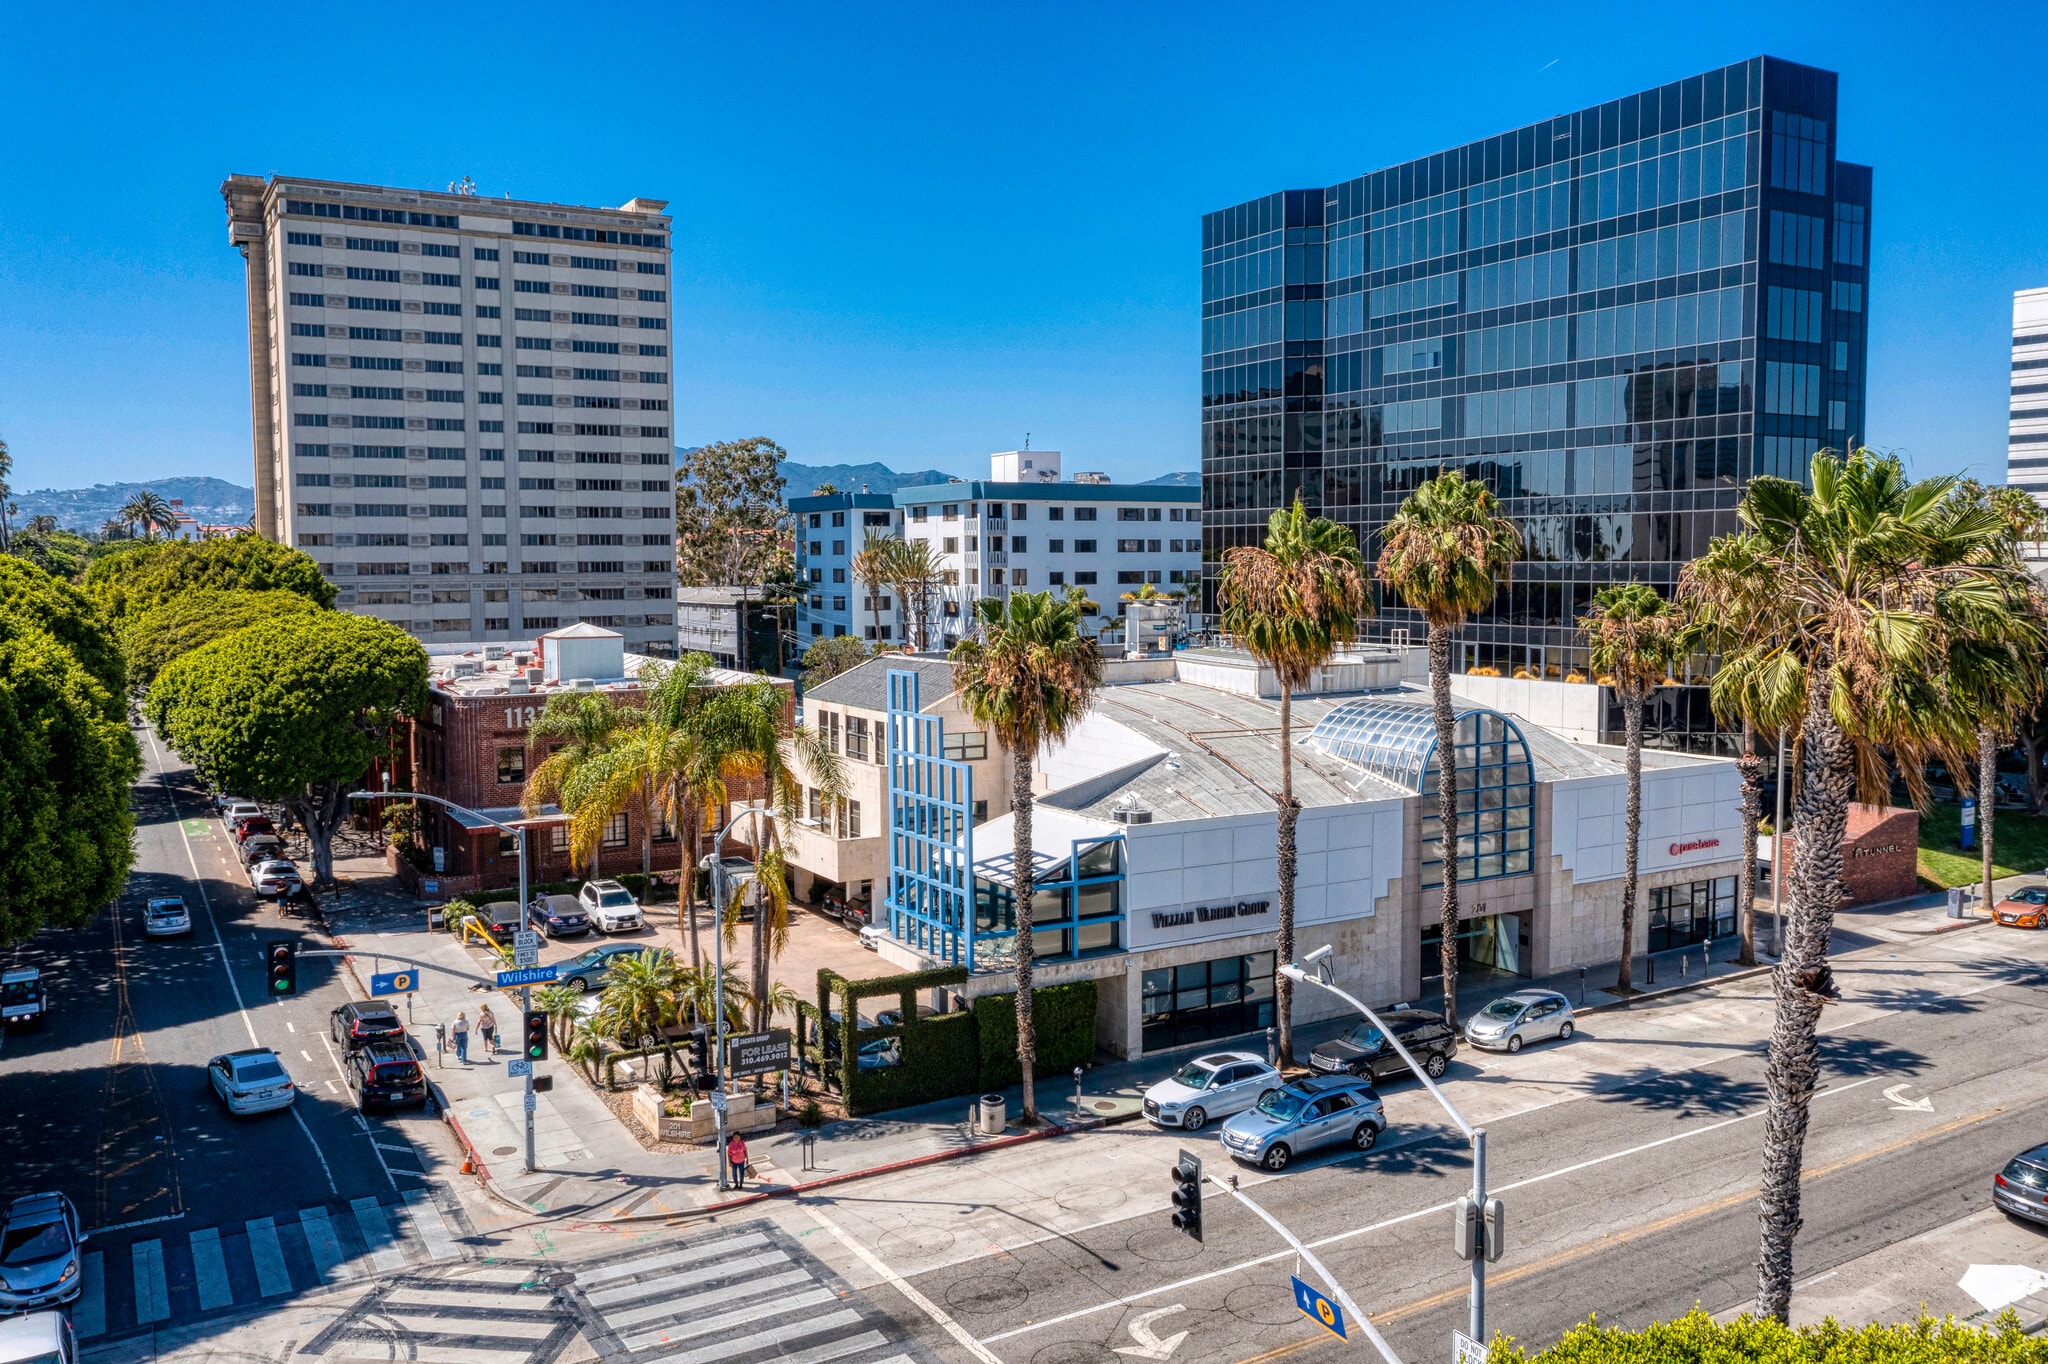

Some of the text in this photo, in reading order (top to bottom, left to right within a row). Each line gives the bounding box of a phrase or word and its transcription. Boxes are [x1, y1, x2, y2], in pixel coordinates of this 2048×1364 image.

[1863, 844, 1902, 857] TUNNEL
[518, 938, 534, 946] BLOCK
[501, 968, 554, 984] Wilshire
[741, 1042, 788, 1059] FOR LEASE
[741, 1051, 788, 1066] 310.469.9012
[668, 1122, 681, 1130] 201
[659, 1129, 692, 1139] WILSHIRE
[1460, 1338, 1482, 1358] DO NOT
